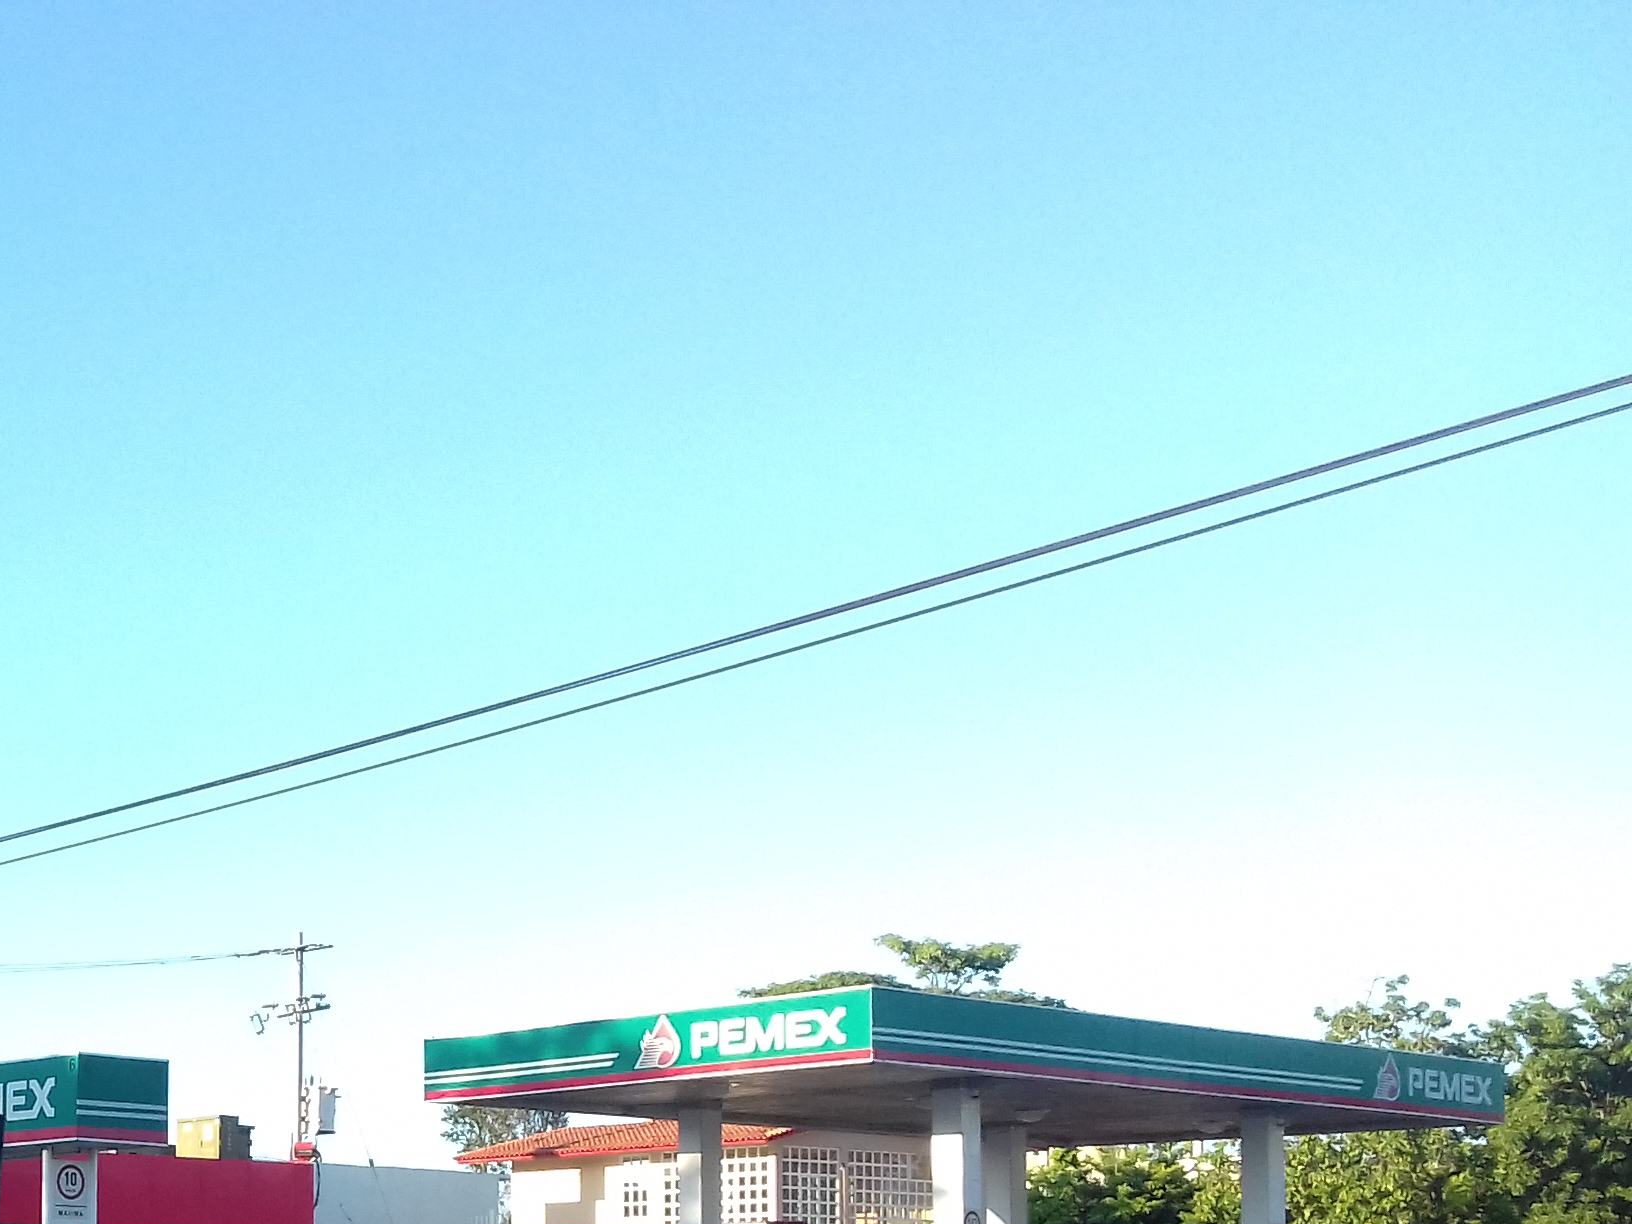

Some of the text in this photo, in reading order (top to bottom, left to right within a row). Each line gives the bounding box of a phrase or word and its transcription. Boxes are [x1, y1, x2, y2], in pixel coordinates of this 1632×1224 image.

[690, 1006, 847, 1059] PEMEX
[1408, 1066, 1492, 1105] PEMEX
[64, 1171, 77, 1187] 10
